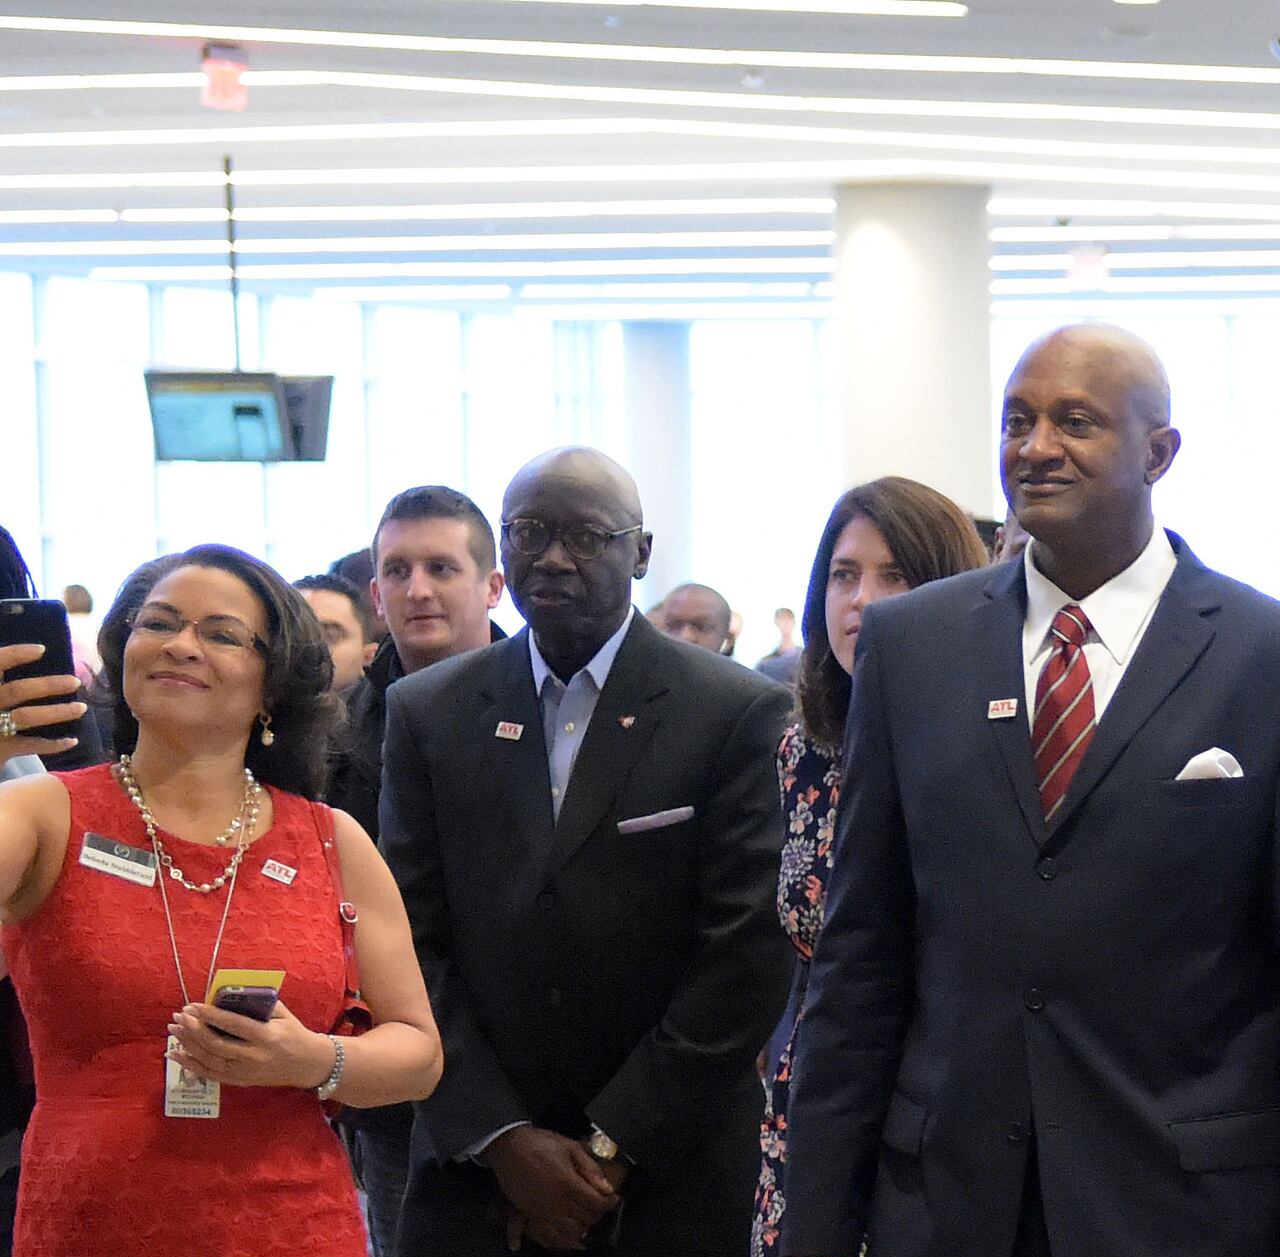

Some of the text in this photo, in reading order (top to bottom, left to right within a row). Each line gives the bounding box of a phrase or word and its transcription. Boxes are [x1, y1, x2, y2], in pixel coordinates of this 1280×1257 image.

[991, 701, 1015, 711] ATL
[499, 723, 519, 736] ATL
[265, 862, 292, 879] ATL
